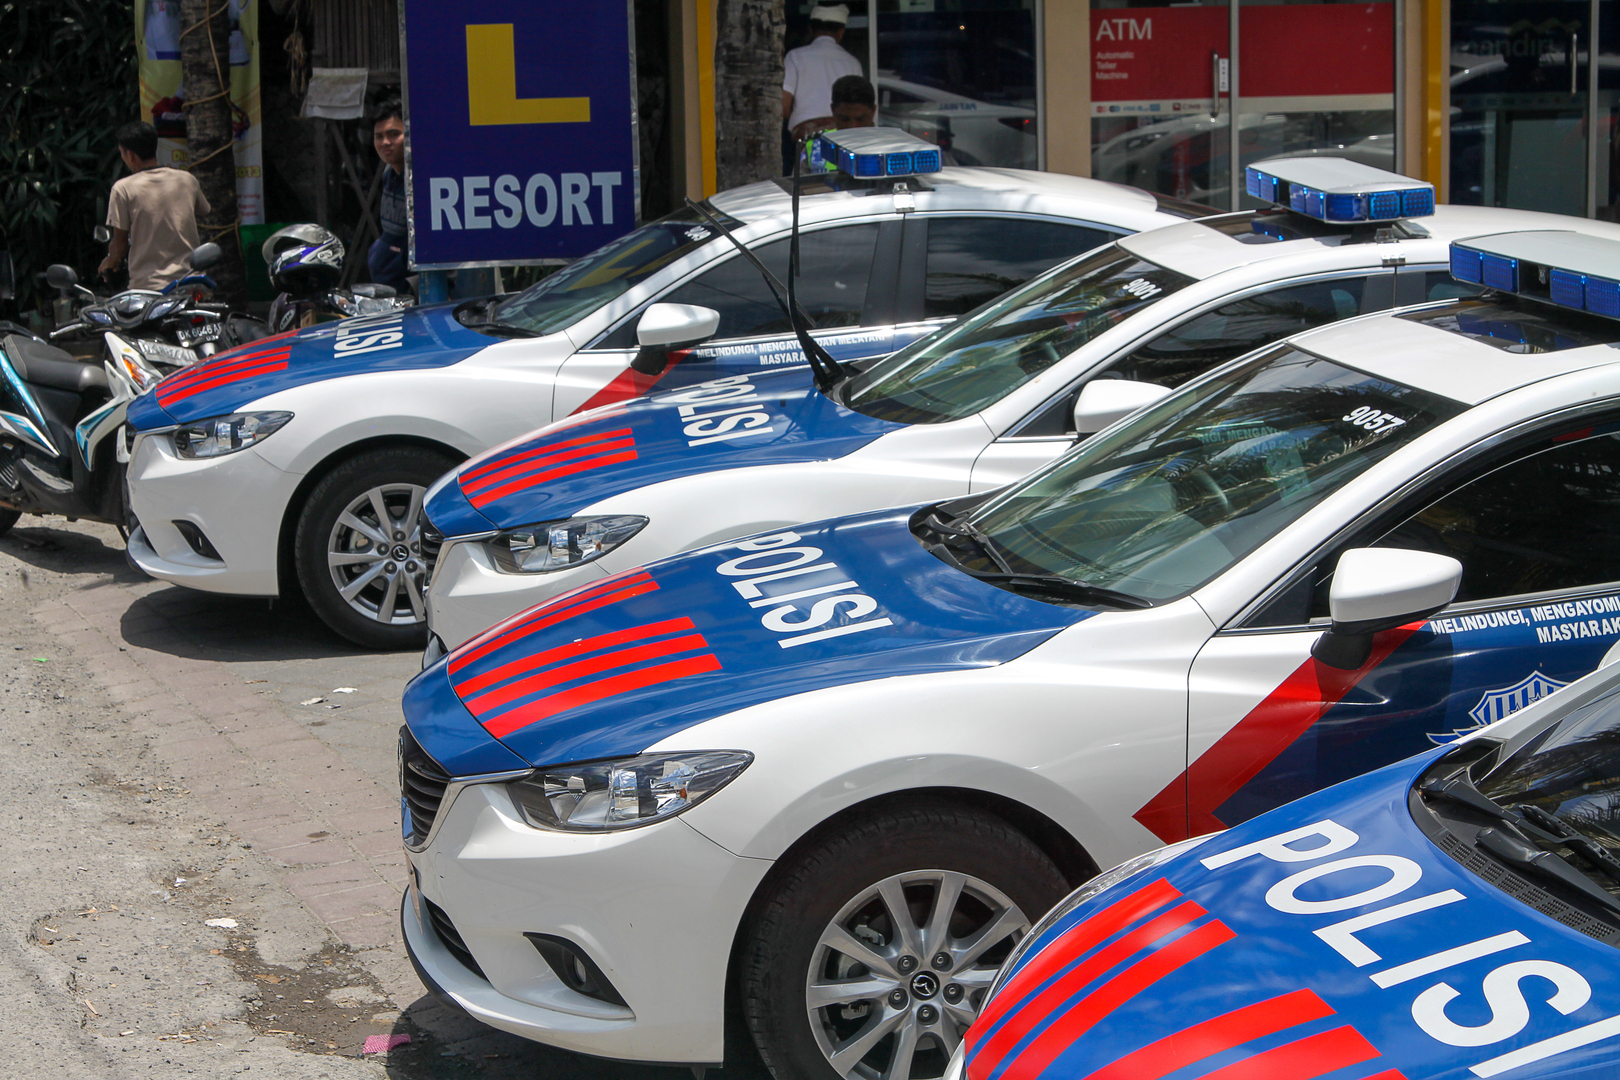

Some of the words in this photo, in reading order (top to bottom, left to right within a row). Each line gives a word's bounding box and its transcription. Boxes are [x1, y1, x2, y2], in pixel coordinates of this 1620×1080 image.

[1096, 18, 1152, 40] ATM
[1096, 51, 1134, 59] Automatic
[466, 23, 591, 126] L
[430, 172, 622, 230] RESORT
[1122, 278, 1163, 300] 9001
[697, 344, 757, 358] MELINDUNGI,
[671, 376, 774, 447] POLISI
[1342, 405, 1407, 434] 9057
[702, 530, 894, 649] POLISI
[1430, 609, 1530, 635] MELINDUNGI,
[1200, 819, 1620, 1079] POLISI
